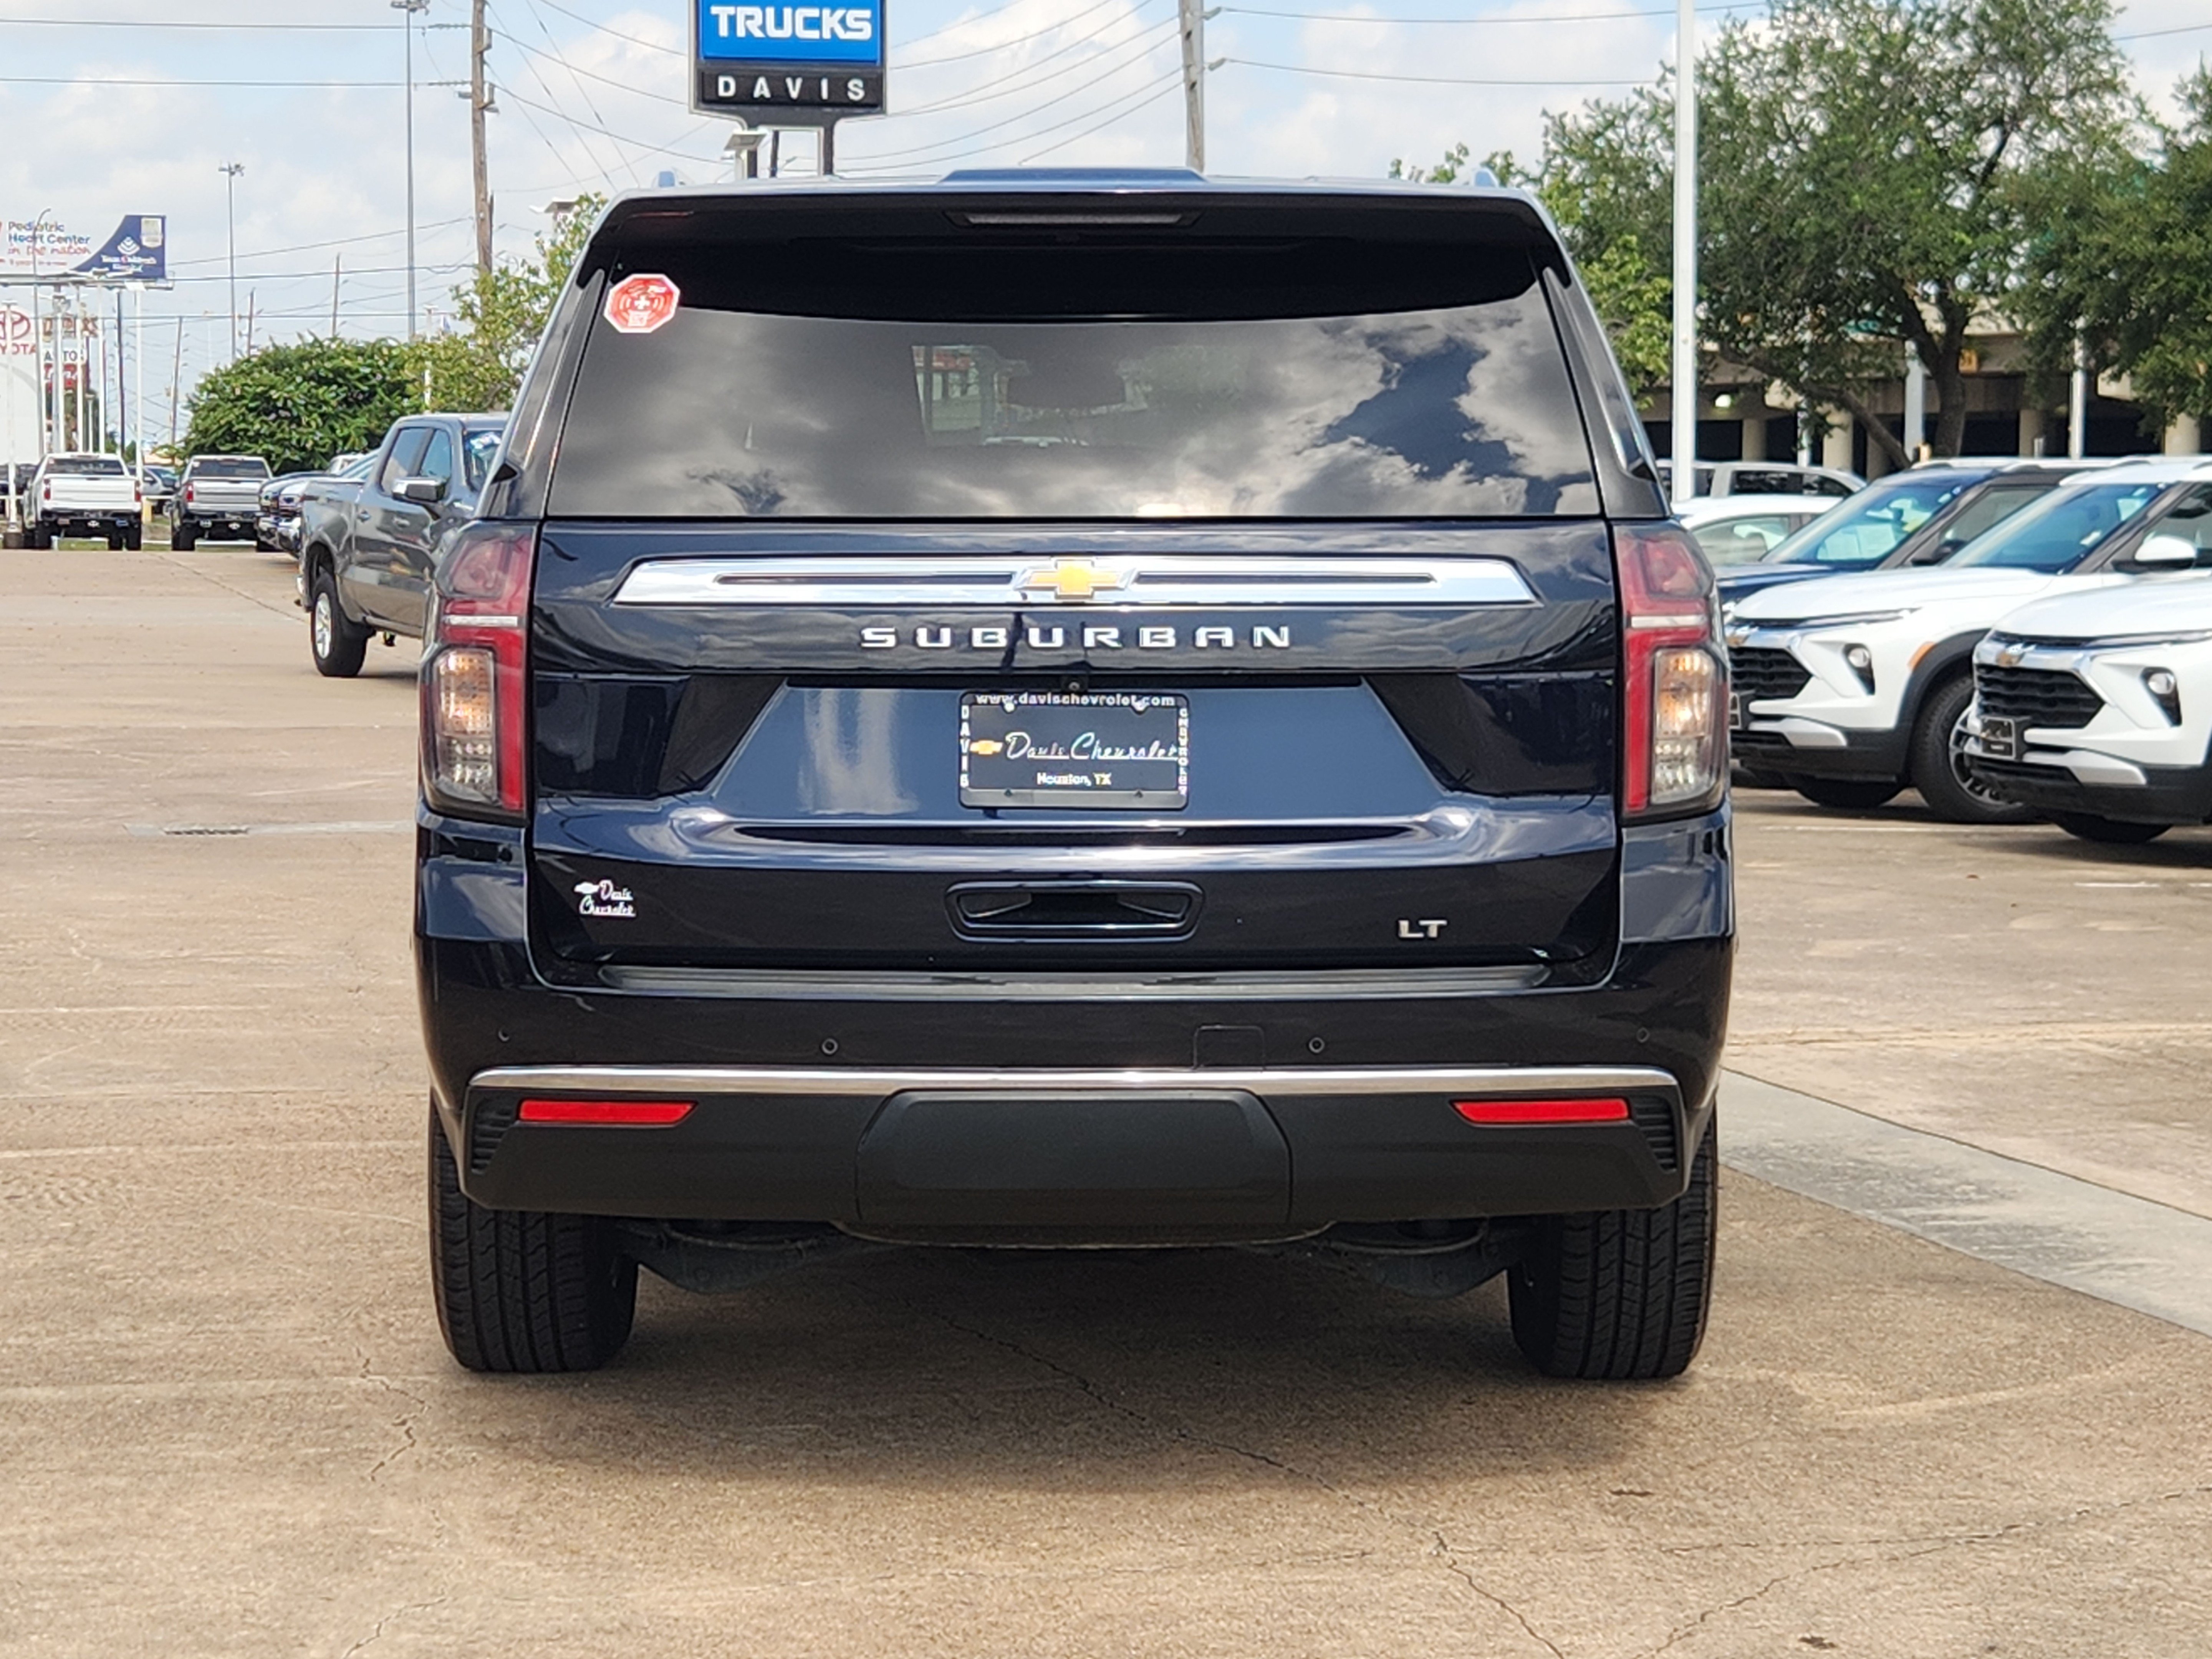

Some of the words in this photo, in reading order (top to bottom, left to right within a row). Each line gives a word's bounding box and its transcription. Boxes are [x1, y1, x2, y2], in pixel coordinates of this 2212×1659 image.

[710, 6, 872, 40] TRUCKS
[717, 76, 865, 101] DAVIS
[8, 221, 65, 232] Pedatric
[47, 233, 91, 245] Center
[860, 626, 1290, 649] SUBURBAN
[975, 692, 1175, 706] www.davischevrolet.com
[960, 705, 970, 788] DAVIS
[1005, 732, 1070, 760] Davis
[1093, 772, 1112, 785] TX
[1398, 920, 1447, 938] LT
